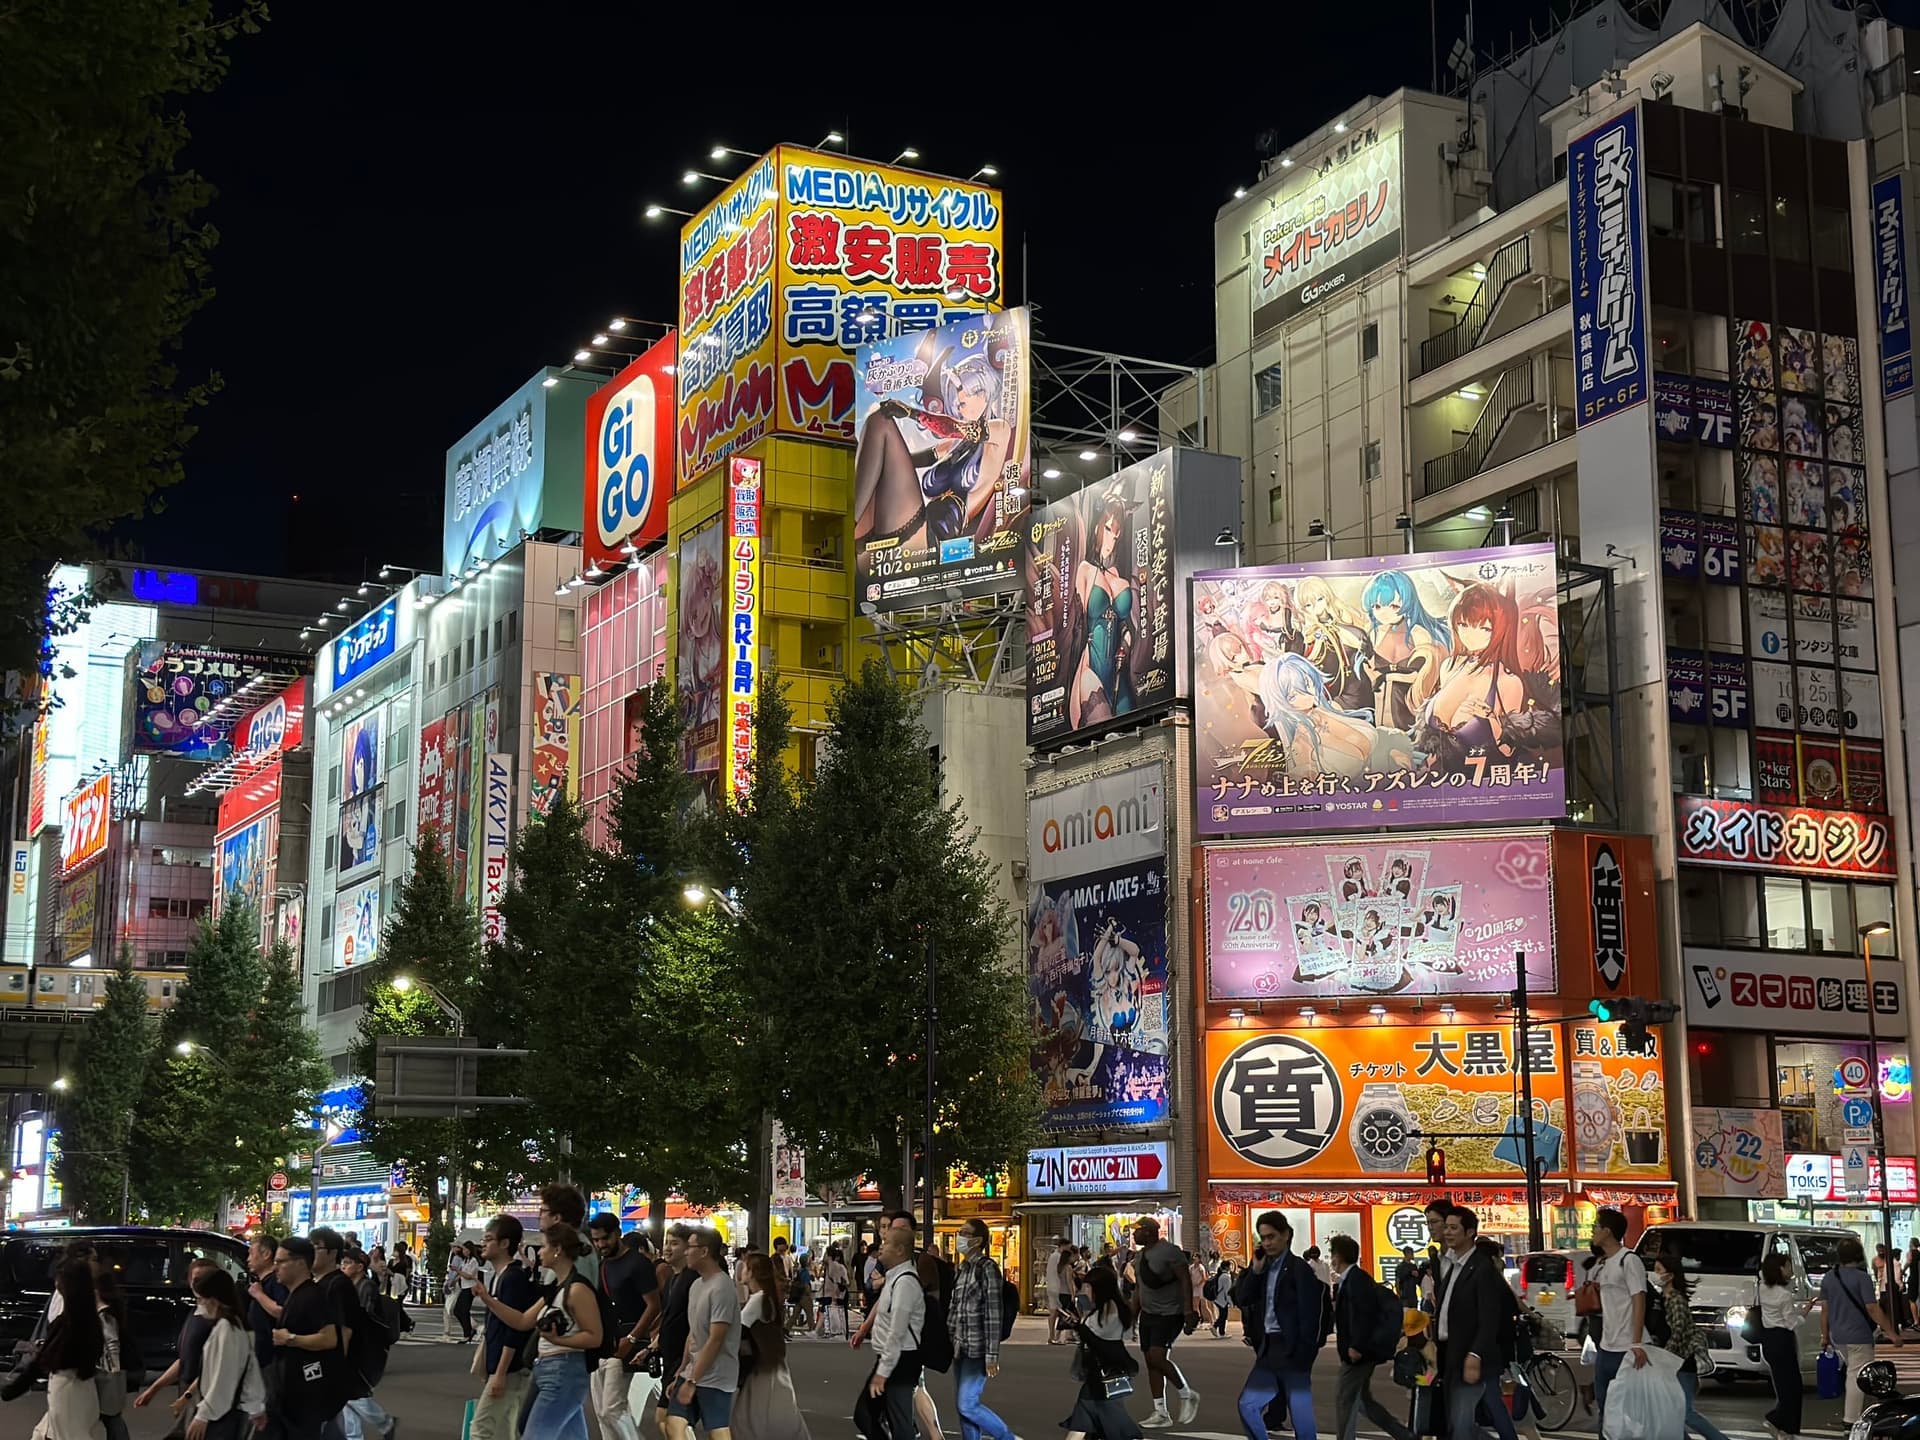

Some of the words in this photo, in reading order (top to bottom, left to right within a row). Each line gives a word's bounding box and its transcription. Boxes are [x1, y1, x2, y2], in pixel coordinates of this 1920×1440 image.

[786, 164, 999, 230] MEDIAリサイクル
[1263, 180, 1388, 288] メイドカジノ
[1576, 162, 1589, 291] トレーディングカードゲーム
[786, 211, 998, 297] 激安販売
[683, 210, 773, 335] 激安販売
[681, 279, 771, 405] 高額買取
[1579, 313, 1594, 391] 秋葉原店
[1698, 412, 1732, 443] 7F
[715, 439, 735, 463] AKIBA
[735, 488, 756, 503] 買取
[735, 504, 756, 519] 販売
[875, 546, 903, 564] 9/12
[876, 561, 903, 577] 10/2
[1150, 464, 1169, 663] 新たな姿で登場
[1703, 547, 1740, 578] 6F
[165, 656, 262, 678] ラブメルシ
[243, 654, 269, 662] PARK
[1711, 688, 1747, 719] 5F
[488, 758, 508, 832] AKKY
[1760, 773, 1791, 789] Stars
[1335, 801, 1368, 811] YOSTAR
[1043, 794, 1148, 853] amiami
[1684, 806, 1887, 868] メイドカジノ
[487, 853, 506, 894] Tax
[1240, 941, 1280, 951] Anniversary
[1732, 975, 1899, 1013] スマホ修理王
[1415, 1030, 1557, 1076] 大黒屋
[1350, 1062, 1407, 1077] チケット
[1846, 1065, 1863, 1080] 40
[1230, 1054, 1330, 1150] 質
[1850, 1106, 1861, 1126] P
[1736, 1133, 1763, 1160] 22
[1069, 1157, 1114, 1180] COMIC
[1117, 1156, 1138, 1179] ZIN
[1068, 1183, 1107, 1192] Akihabara
[1393, 1214, 1426, 1247] 質
